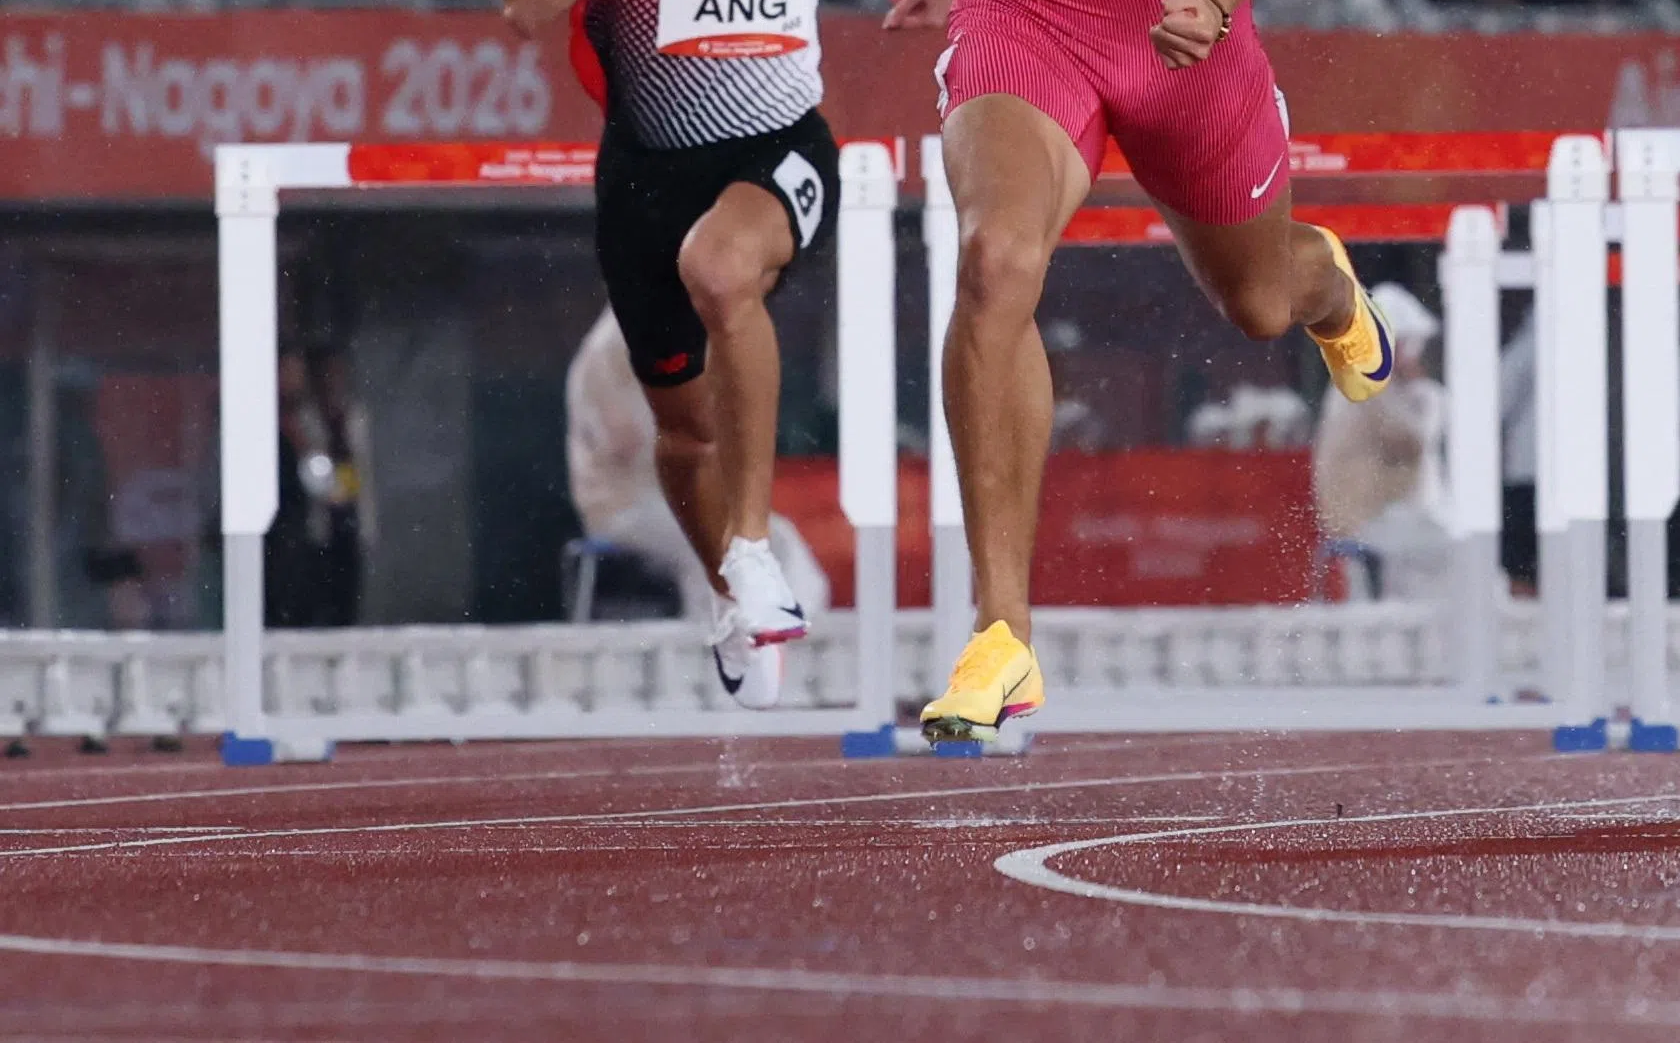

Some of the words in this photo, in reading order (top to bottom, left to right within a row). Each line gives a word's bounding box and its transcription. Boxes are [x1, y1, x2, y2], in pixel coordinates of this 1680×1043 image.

[0, 34, 366, 149] hi-Nagoya
[381, 40, 552, 137] 2026
[794, 178, 816, 217] 8
